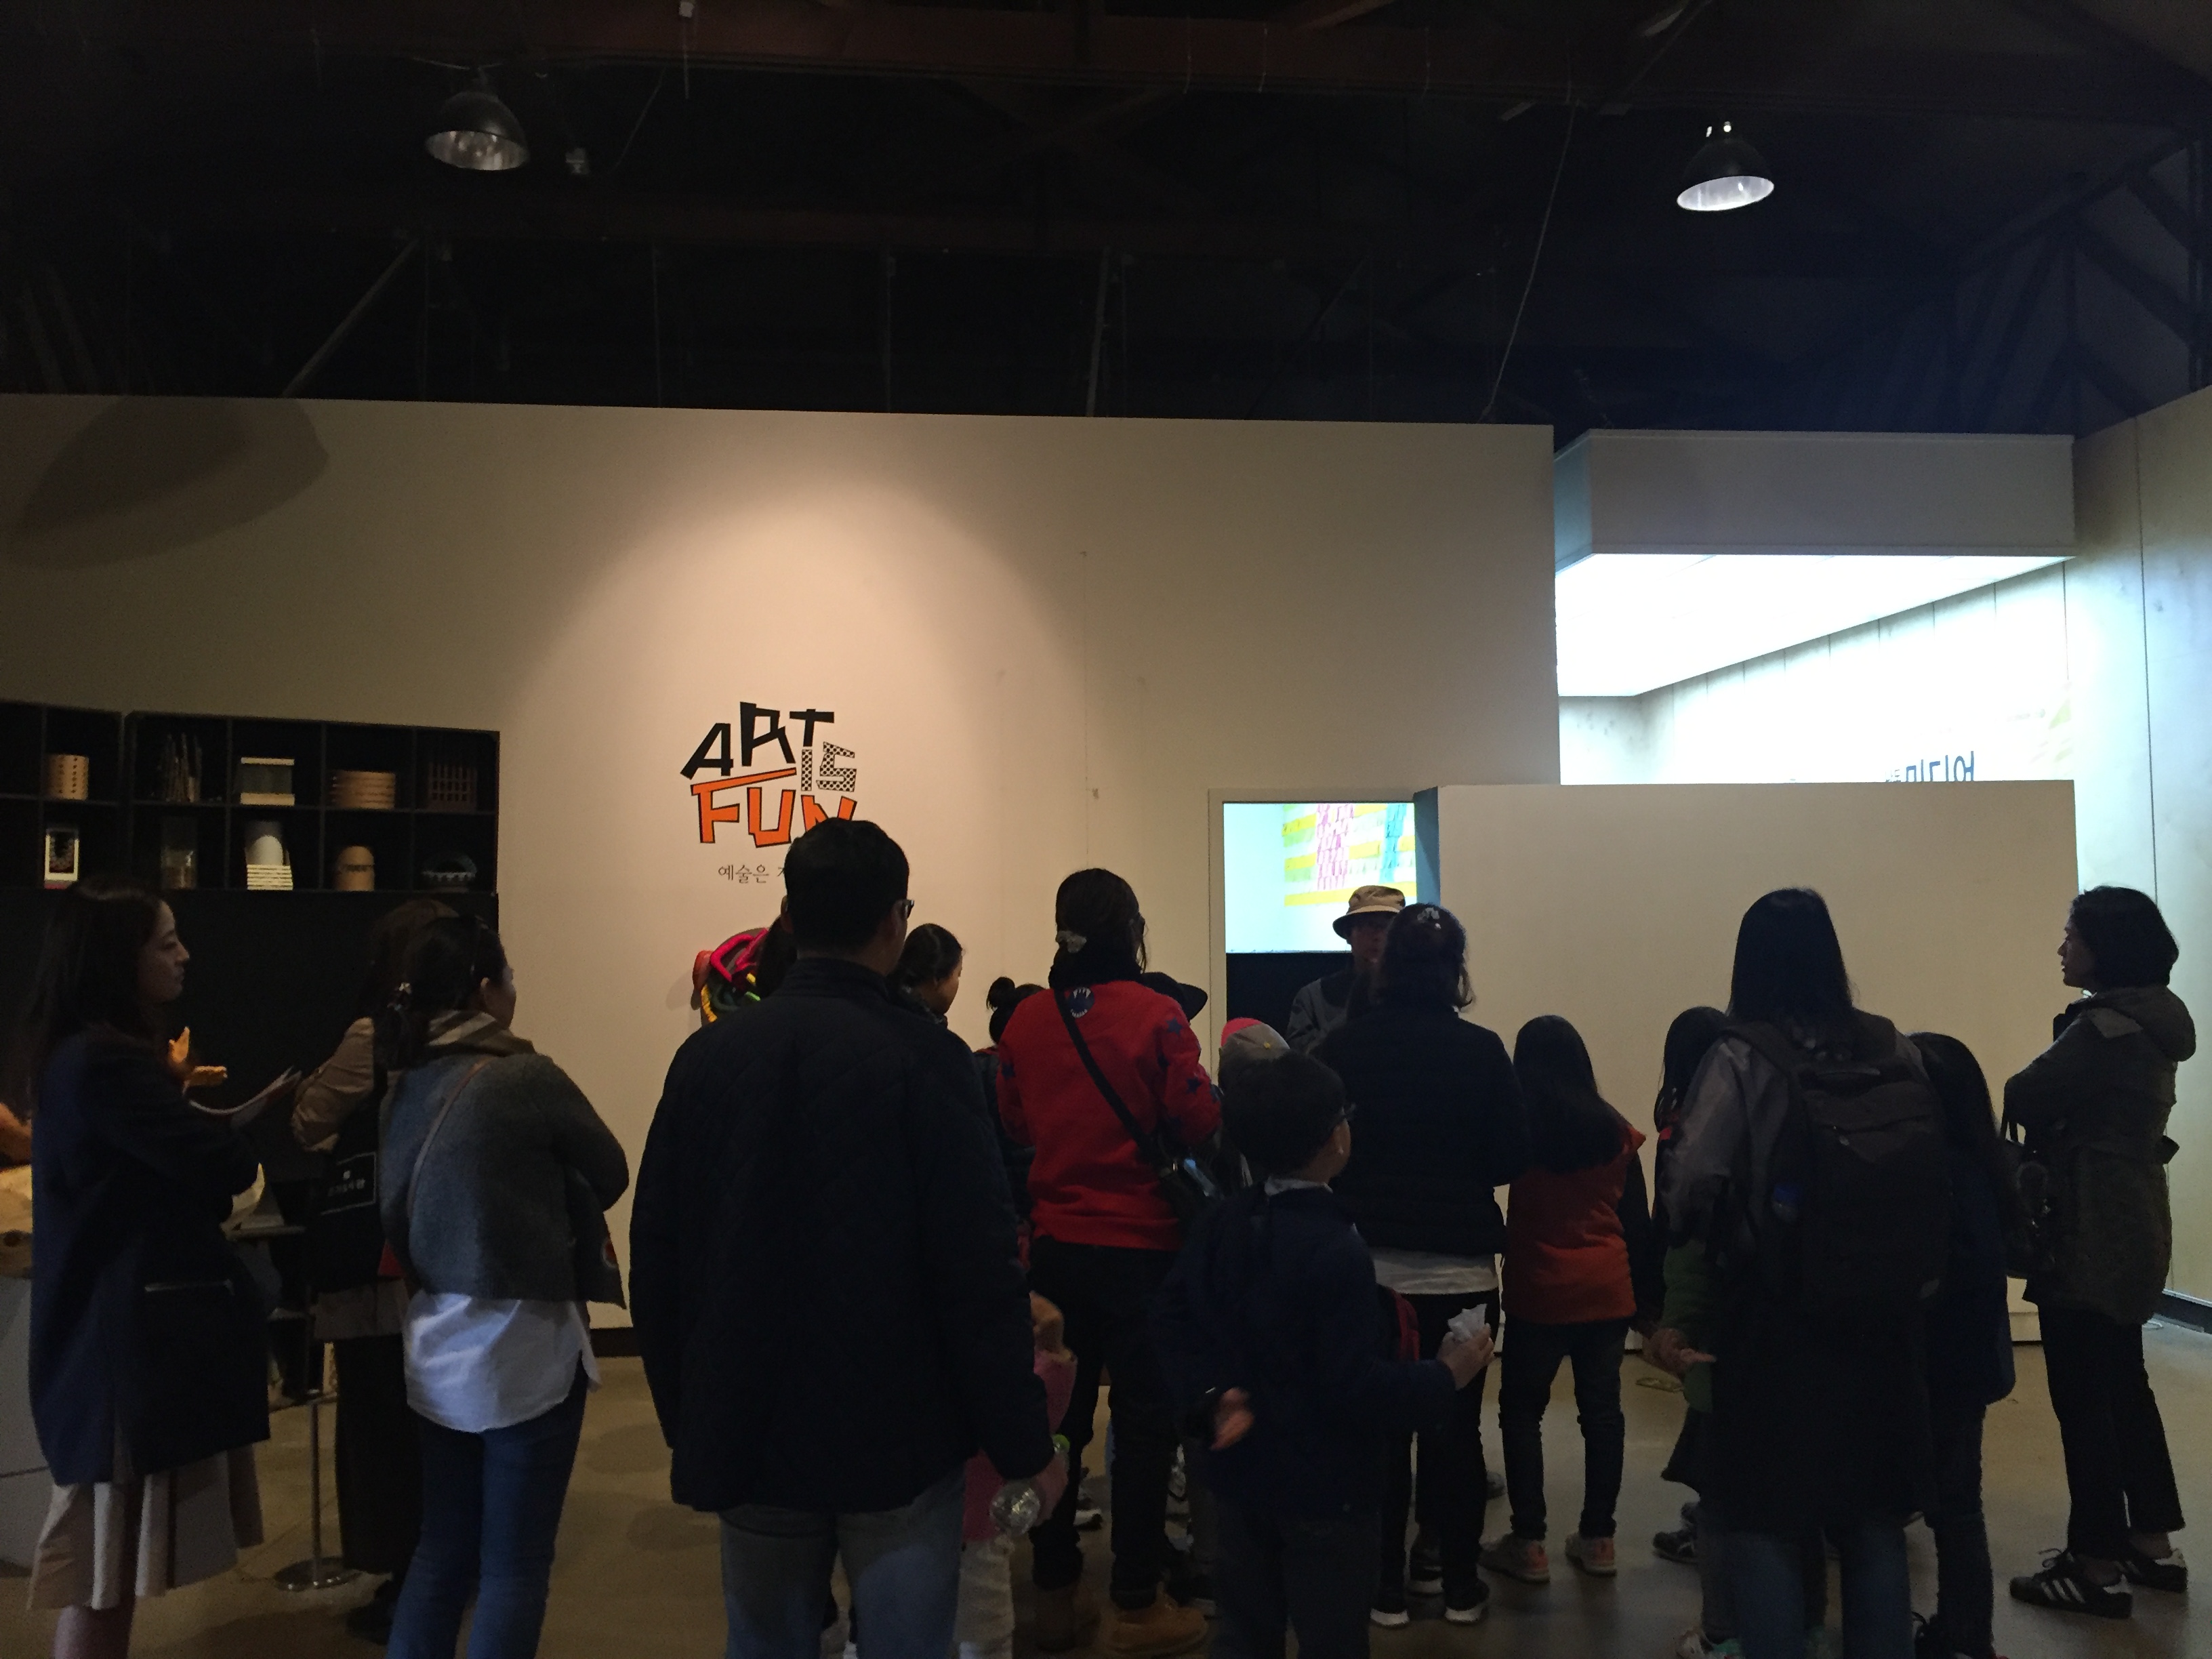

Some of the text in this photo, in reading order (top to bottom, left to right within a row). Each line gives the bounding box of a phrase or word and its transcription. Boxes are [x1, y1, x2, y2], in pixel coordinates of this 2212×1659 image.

[680, 701, 834, 780] ART
[800, 741, 857, 792] IS
[718, 864, 769, 884] 예술은
